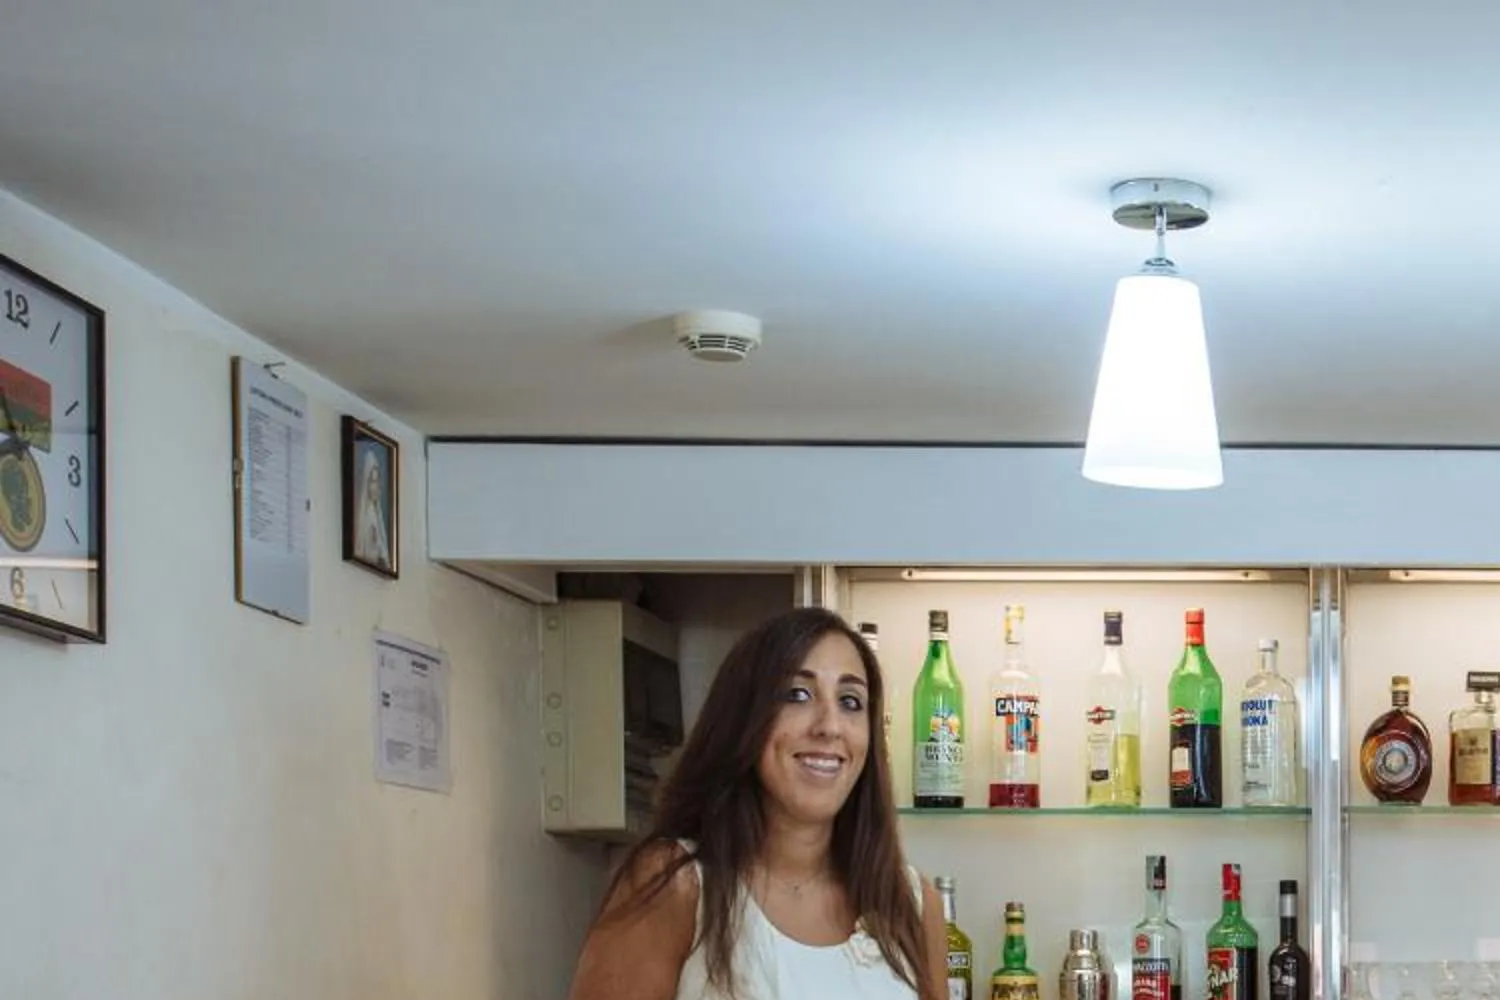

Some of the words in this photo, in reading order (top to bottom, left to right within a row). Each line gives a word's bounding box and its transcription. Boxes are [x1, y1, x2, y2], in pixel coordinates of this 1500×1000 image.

[4, 289, 29, 329] 12
[68, 455, 81, 488] 3
[10, 566, 25, 600] 6
